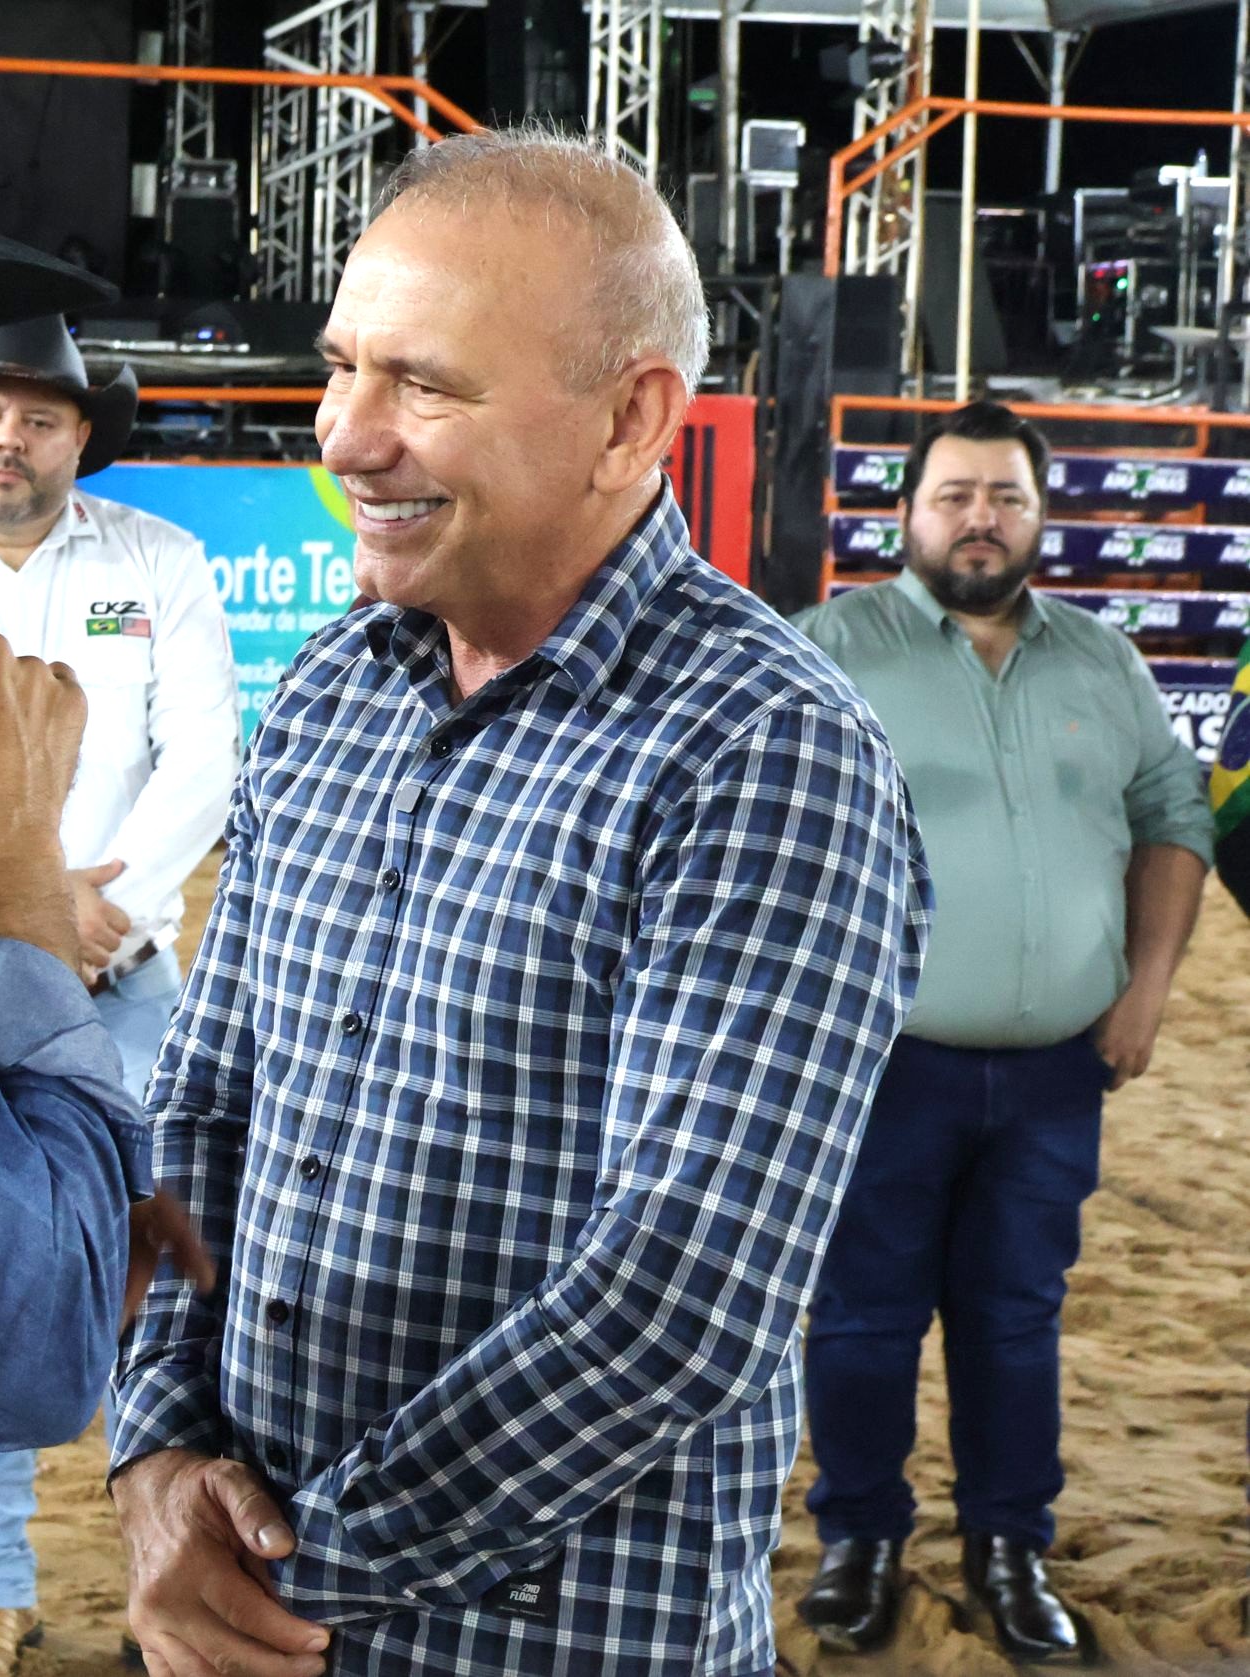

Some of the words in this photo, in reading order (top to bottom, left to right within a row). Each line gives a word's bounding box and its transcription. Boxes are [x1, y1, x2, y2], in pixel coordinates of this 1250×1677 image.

[200, 541, 296, 604] orte
[90, 601, 146, 615] CKZ
[521, 1583, 541, 1594] 2ND
[509, 1591, 538, 1604] FLOOR
